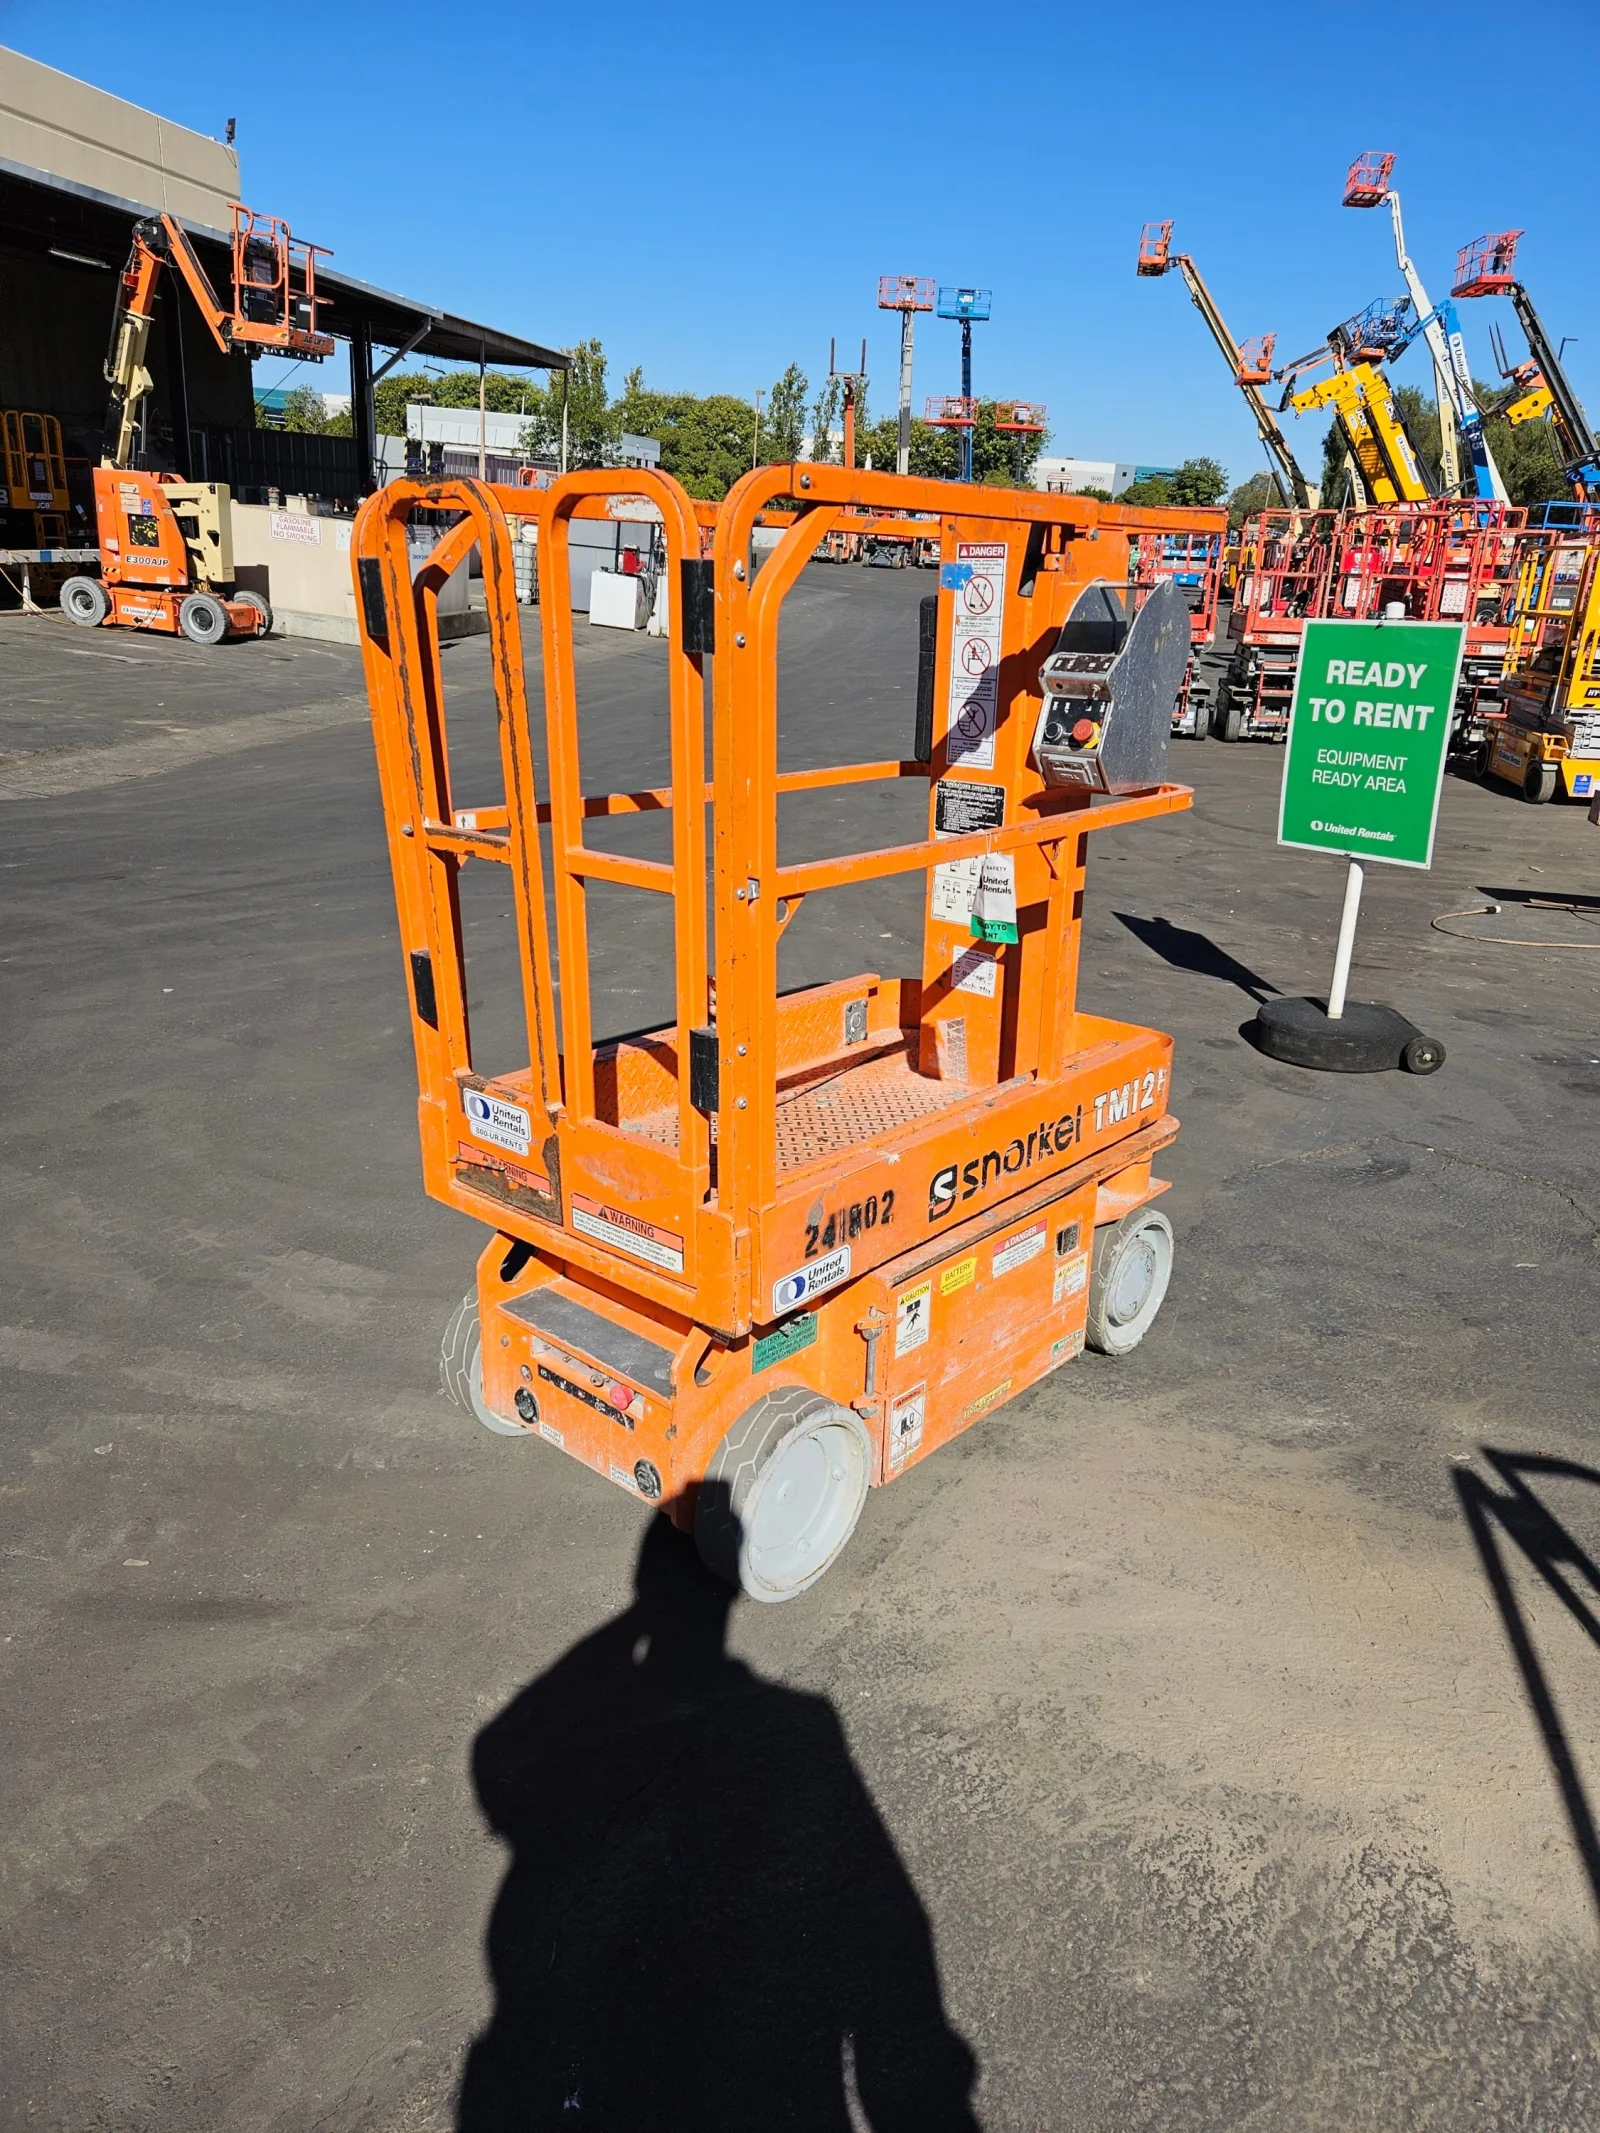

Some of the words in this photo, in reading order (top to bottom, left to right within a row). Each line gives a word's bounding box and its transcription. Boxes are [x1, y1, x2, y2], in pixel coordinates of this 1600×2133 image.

[1455, 349, 1467, 378] United
[1356, 408, 1368, 427] JCB
[1383, 400, 1397, 420] JCB
[1445, 450, 1453, 464] JLG
[1446, 466, 1454, 483] LIFT
[1356, 483, 1365, 501] LIFT
[276, 522, 314, 535] FLAMMABLE
[278, 515, 312, 527] GASOLINE
[273, 530, 285, 538] NO
[286, 532, 318, 542] SMOKING
[126, 555, 169, 566] E300AJP
[969, 546, 1004, 557] DANGER
[1326, 659, 1428, 689] READY
[1309, 698, 1346, 724] TO
[1353, 701, 1435, 731] RENT
[1317, 748, 1408, 771] EQUIPMENT
[1312, 769, 1362, 788] READY
[1364, 776, 1407, 794] AREA
[1324, 823, 1357, 836] United
[1357, 828, 1396, 842] Rentals
[982, 875, 1010, 886] United
[982, 884, 1012, 895] Rentals
[492, 1104, 522, 1123] United
[493, 1116, 526, 1136] Rentals
[475, 1126, 523, 1151] 800-UR-RENTS
[962, 1104, 1082, 1200] snorkel
[609, 1210, 655, 1238] WARNING
[1010, 1226, 1037, 1246] DANGER
[807, 1254, 842, 1281] United
[944, 1261, 972, 1282] BATTERY
[807, 1266, 845, 1293] Rentals
[905, 1284, 930, 1302] CAUTION
